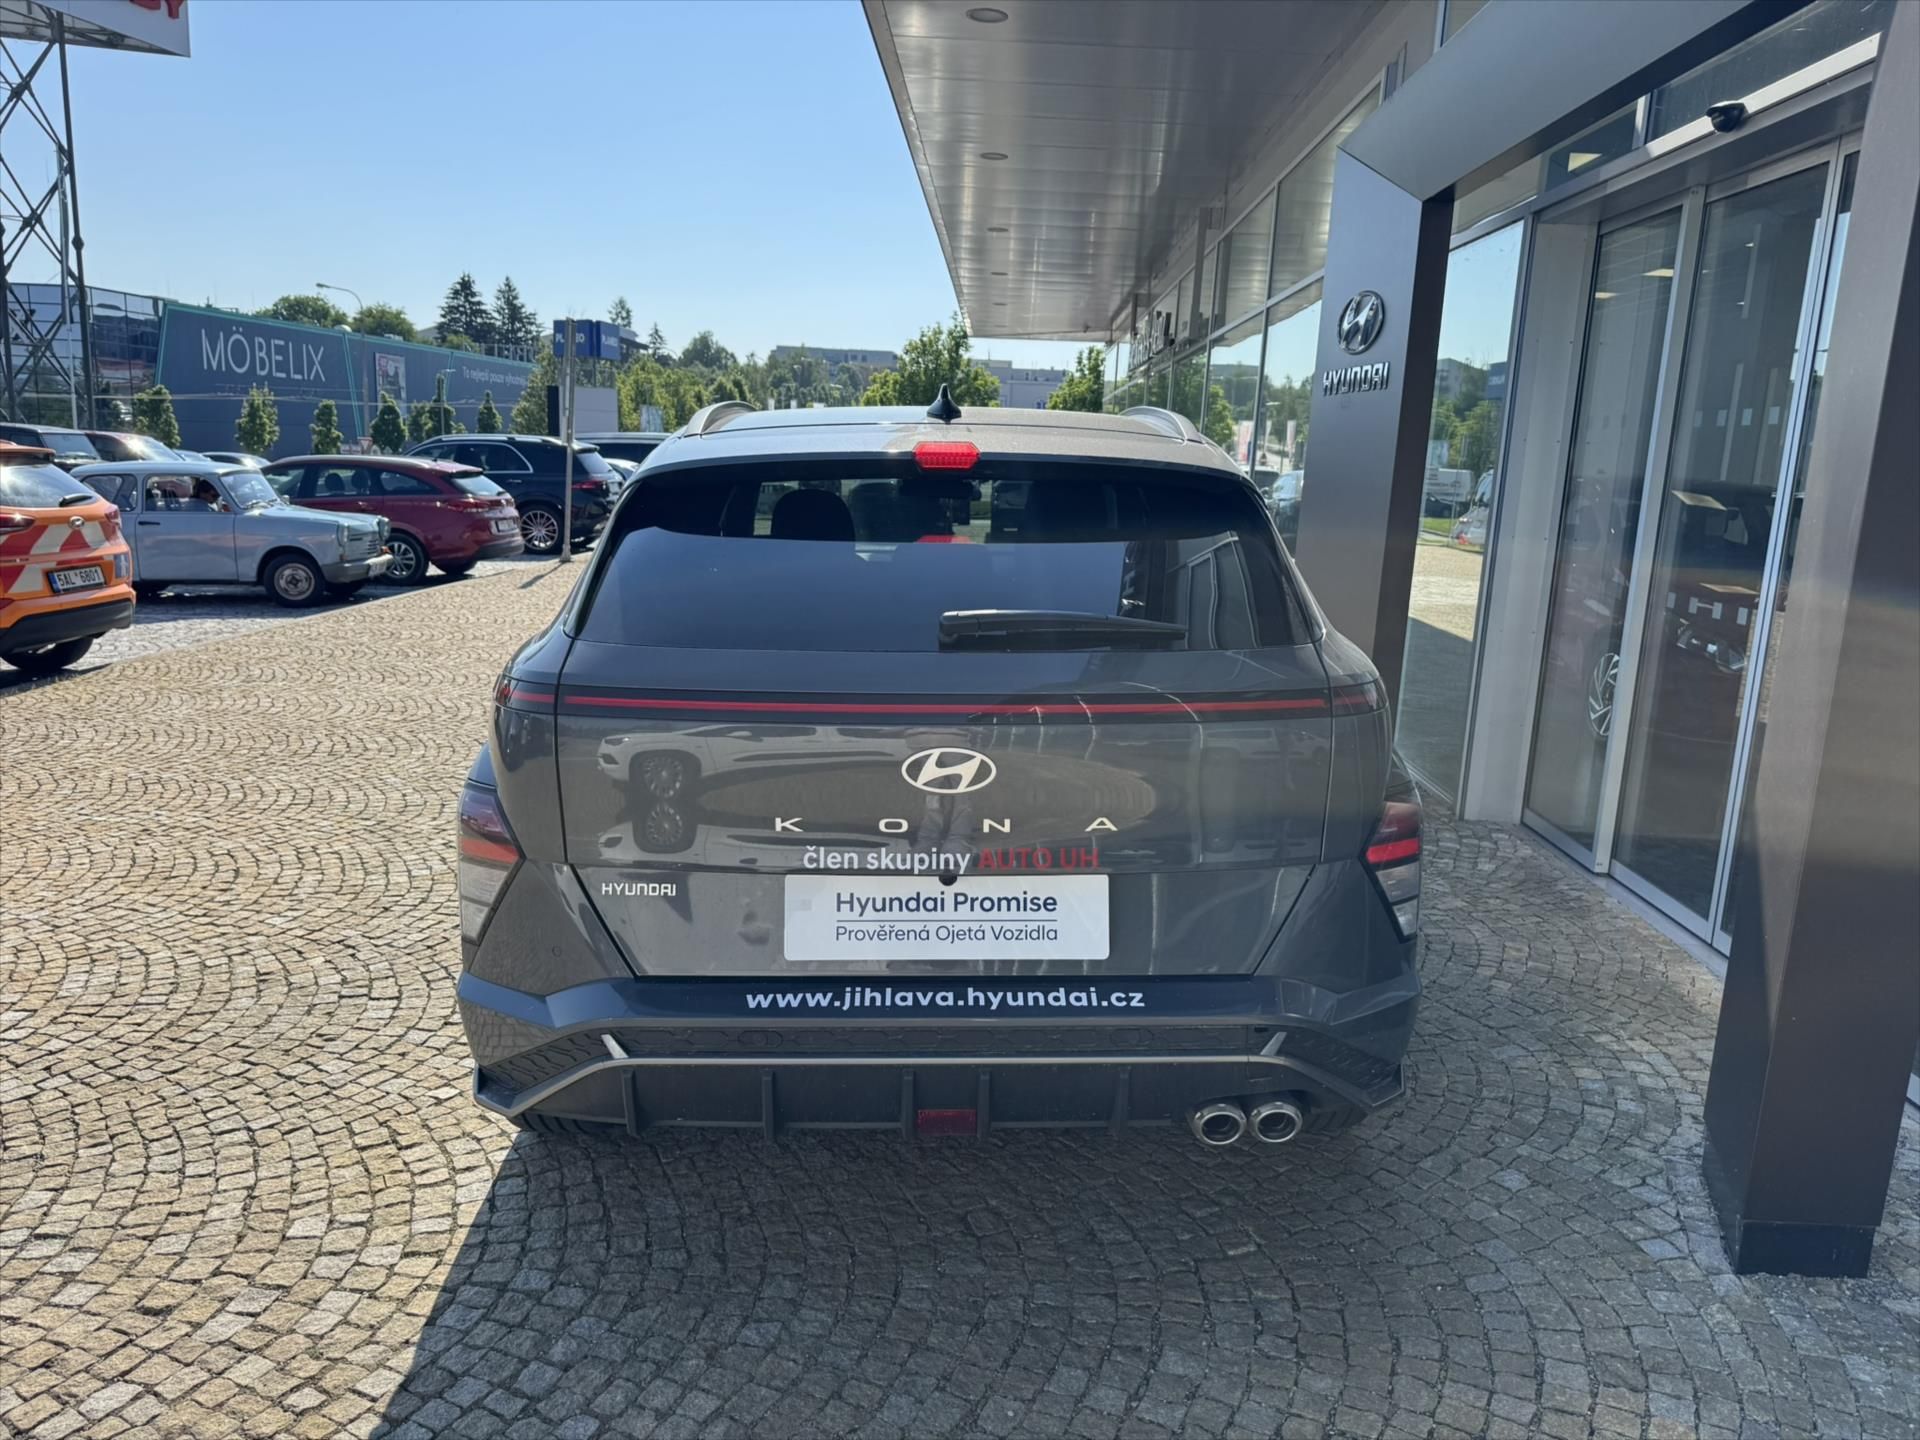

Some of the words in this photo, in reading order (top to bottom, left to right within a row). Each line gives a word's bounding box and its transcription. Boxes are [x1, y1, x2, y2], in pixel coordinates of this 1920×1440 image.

[201, 325, 326, 382] MÖBELIX
[1323, 362, 1391, 397] HYUNDAI
[774, 816, 1119, 833] KONA
[803, 846, 859, 870] člen
[866, 847, 971, 874] skupiny
[978, 848, 1053, 871] AUTO
[1060, 848, 1099, 870] UH
[602, 882, 676, 896] HYUNDAI
[836, 891, 945, 917] Hyundai
[953, 891, 1058, 913] Promise
[836, 924, 930, 942] Prověřená
[935, 924, 985, 945] Ojetá
[991, 925, 1058, 941] Vozidla
[745, 986, 1145, 1011] www.jihlava.hyundai.cz
